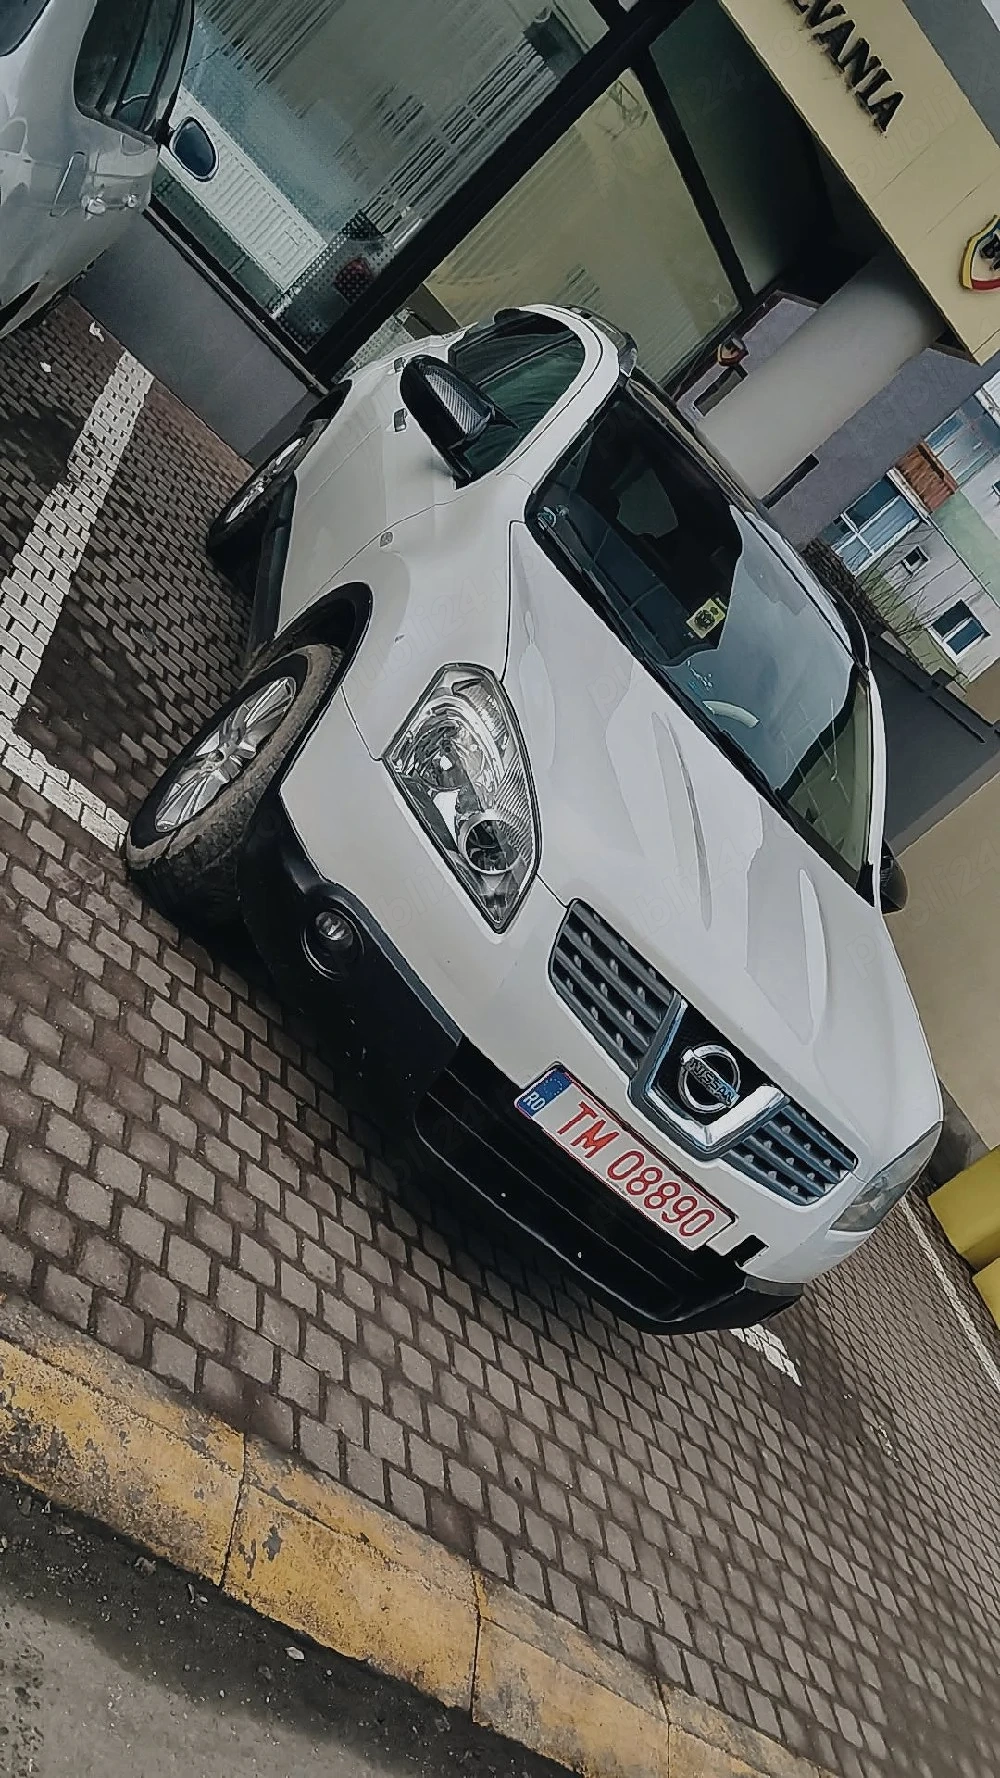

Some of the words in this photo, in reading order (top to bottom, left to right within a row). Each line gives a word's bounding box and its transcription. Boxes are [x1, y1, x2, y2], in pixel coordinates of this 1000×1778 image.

[523, 1092, 546, 1111] RO
[685, 1058, 736, 1106] NISSAN
[557, 1101, 620, 1159] TM
[606, 1150, 715, 1237] 08890
